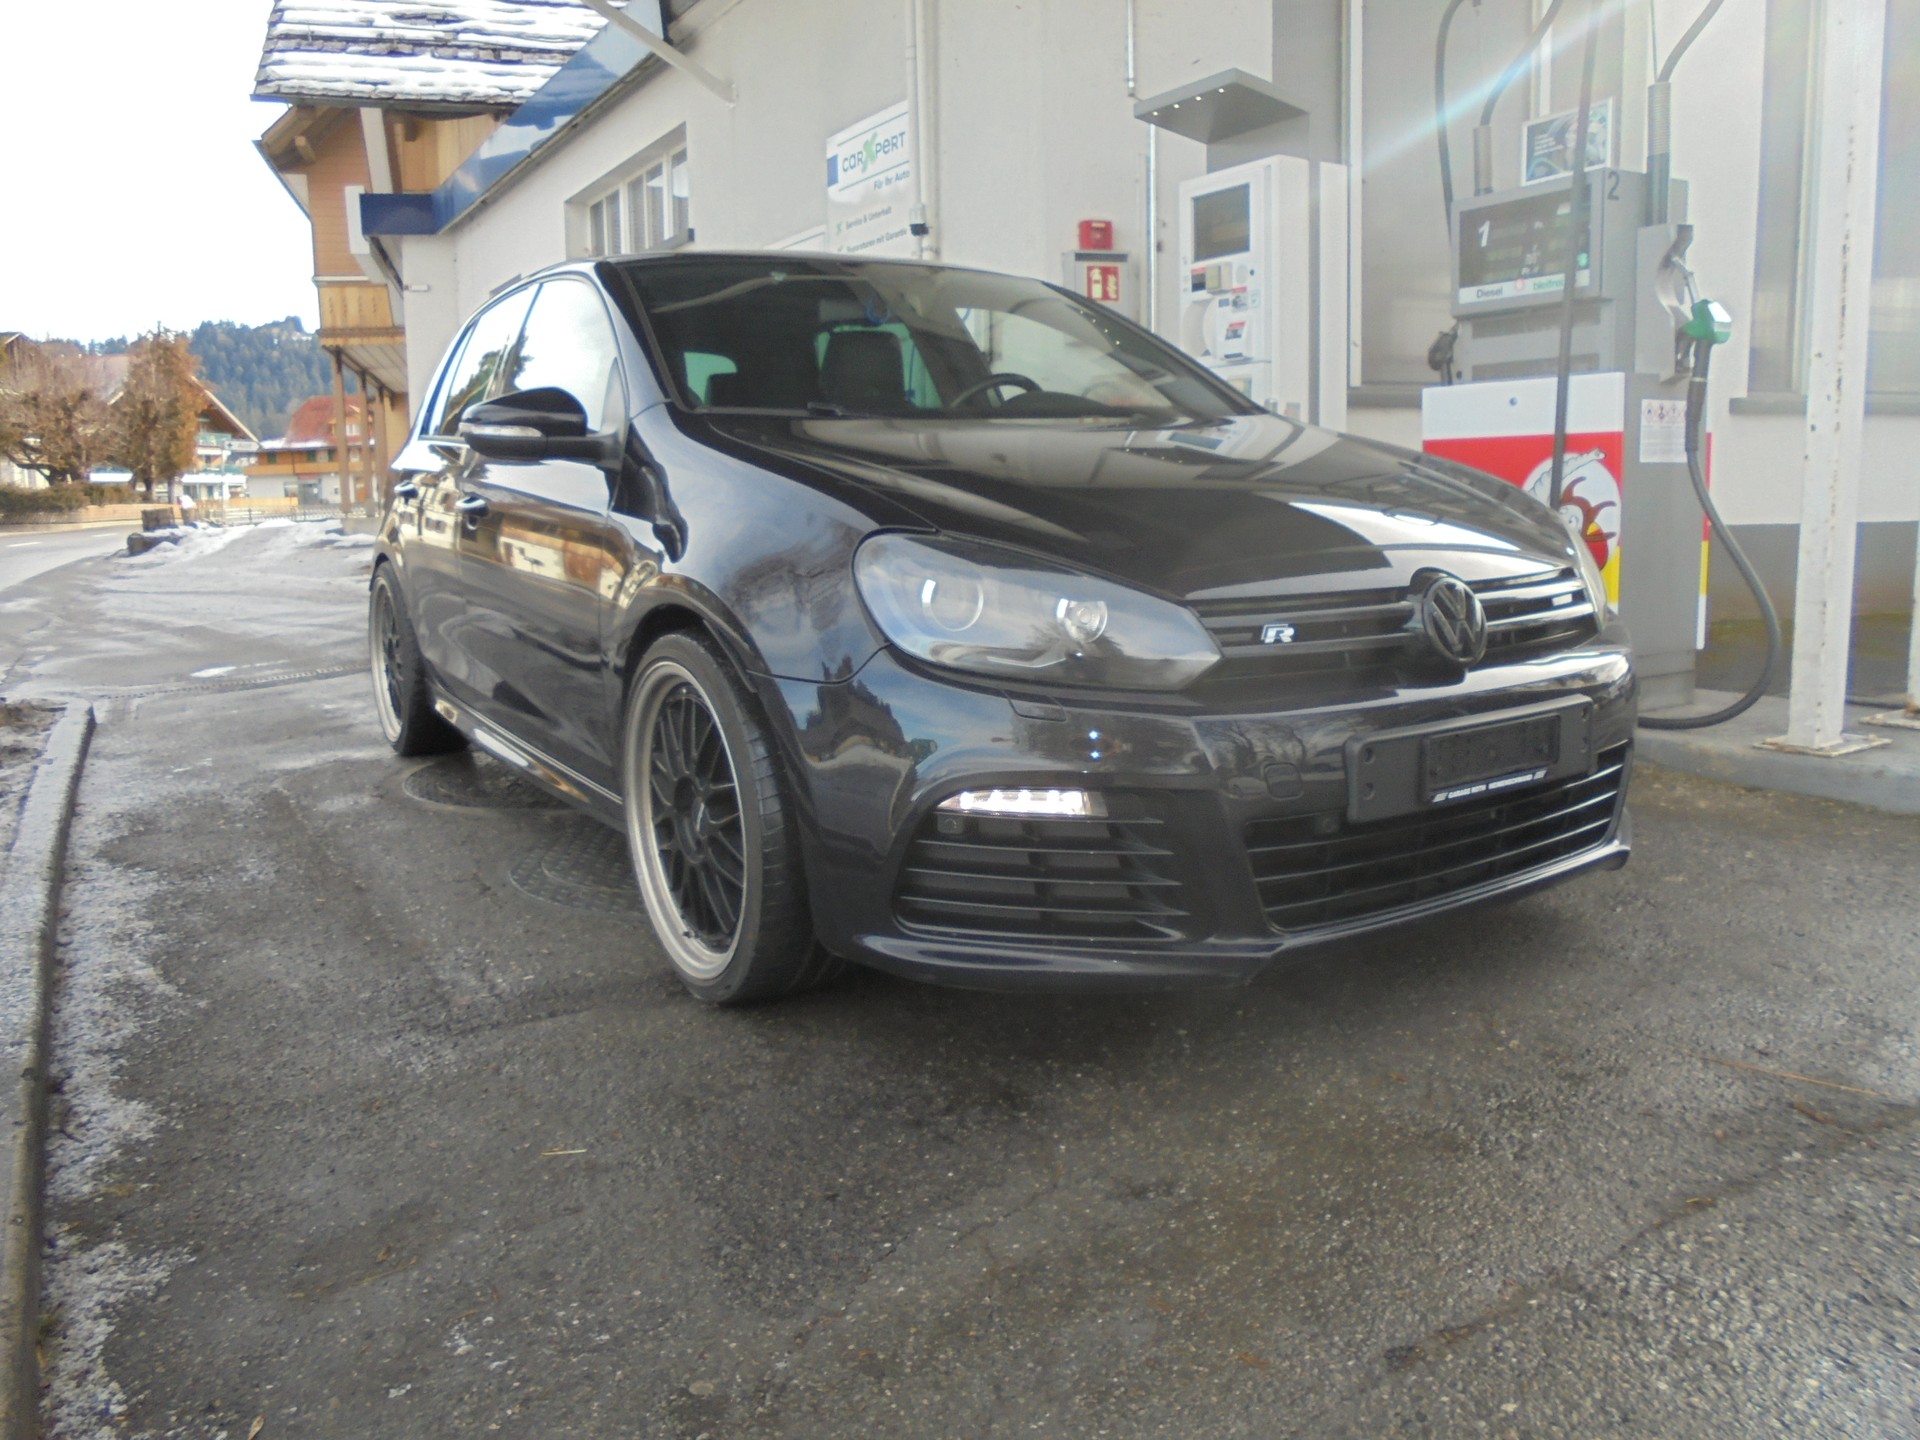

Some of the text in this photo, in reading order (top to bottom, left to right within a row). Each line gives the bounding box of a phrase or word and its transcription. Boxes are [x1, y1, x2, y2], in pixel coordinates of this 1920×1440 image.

[1606, 171, 1619, 200] 2
[1478, 220, 1490, 248] 1
[1476, 287, 1503, 298] Diesel
[1261, 624, 1295, 643] R
